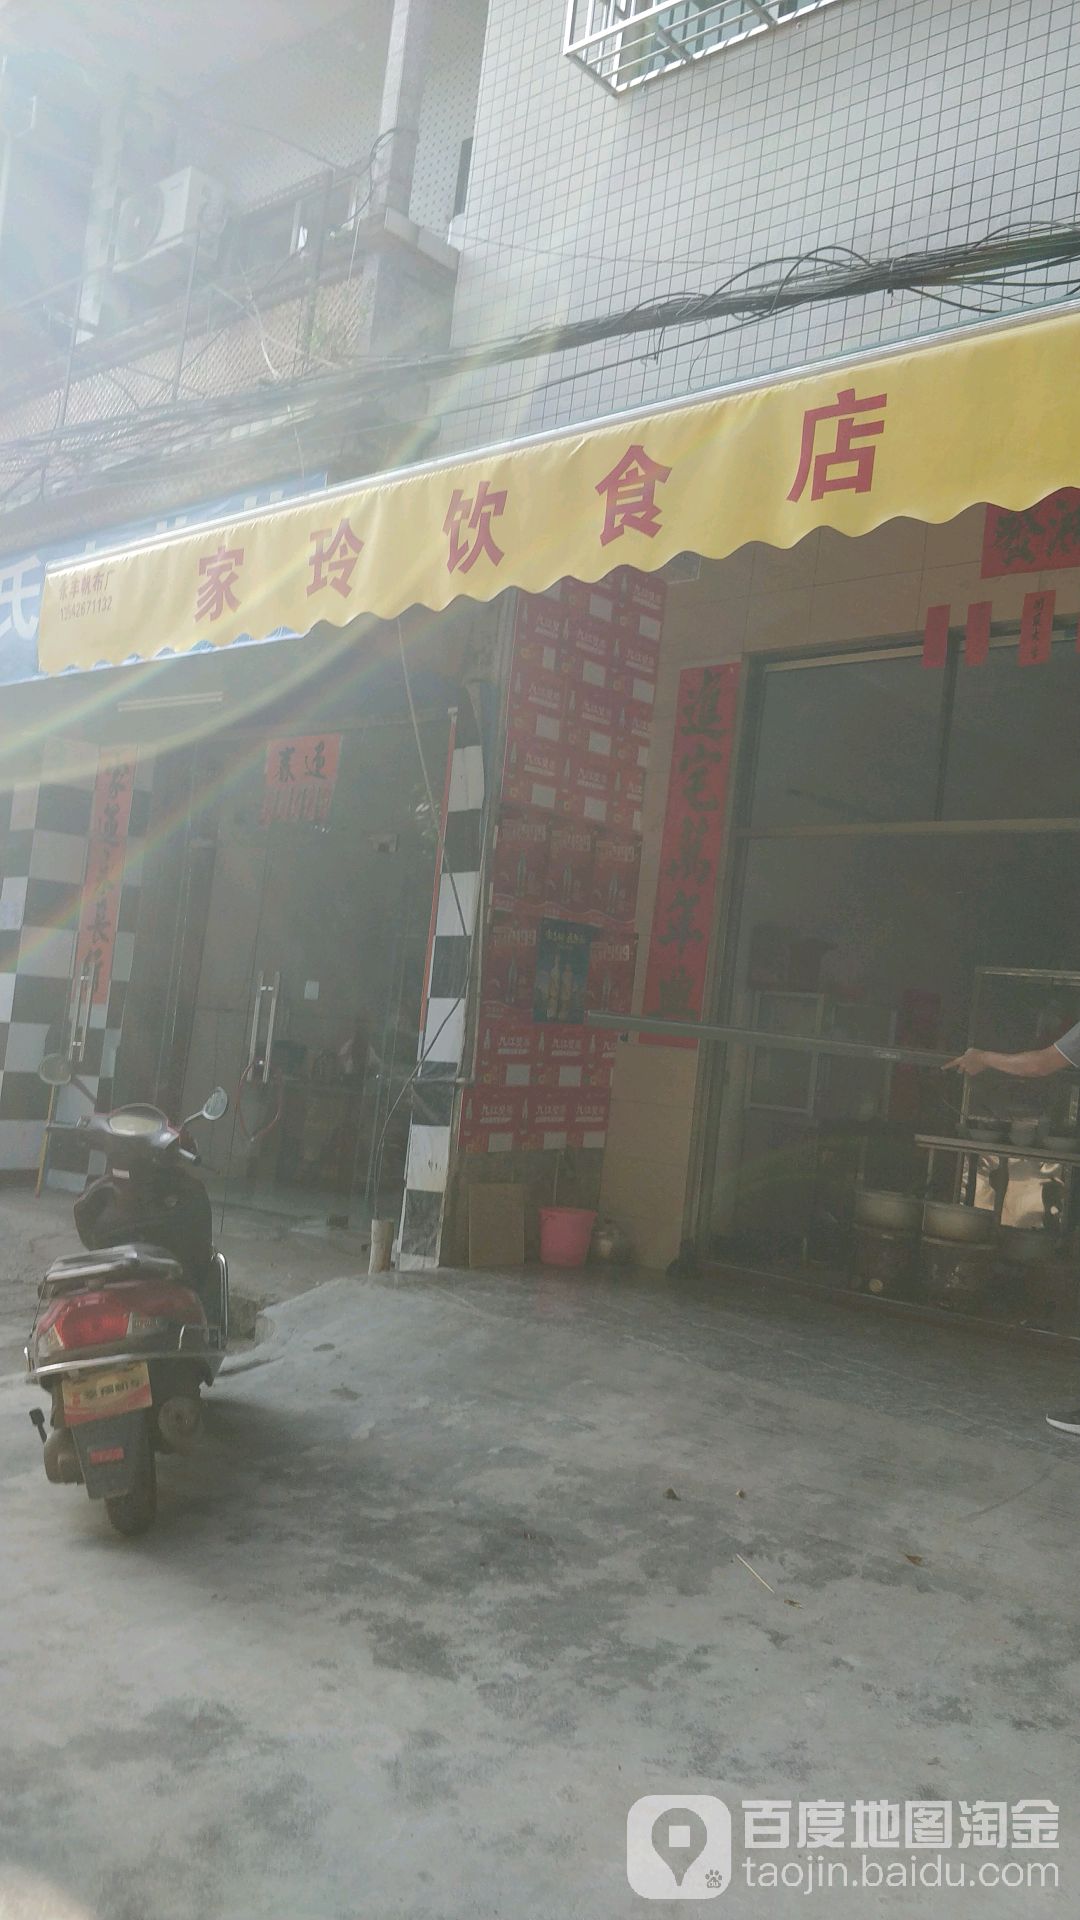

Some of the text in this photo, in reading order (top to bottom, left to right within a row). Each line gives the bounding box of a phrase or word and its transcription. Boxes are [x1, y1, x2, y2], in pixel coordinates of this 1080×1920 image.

[194, 388, 887, 623] 家玲饮食店
